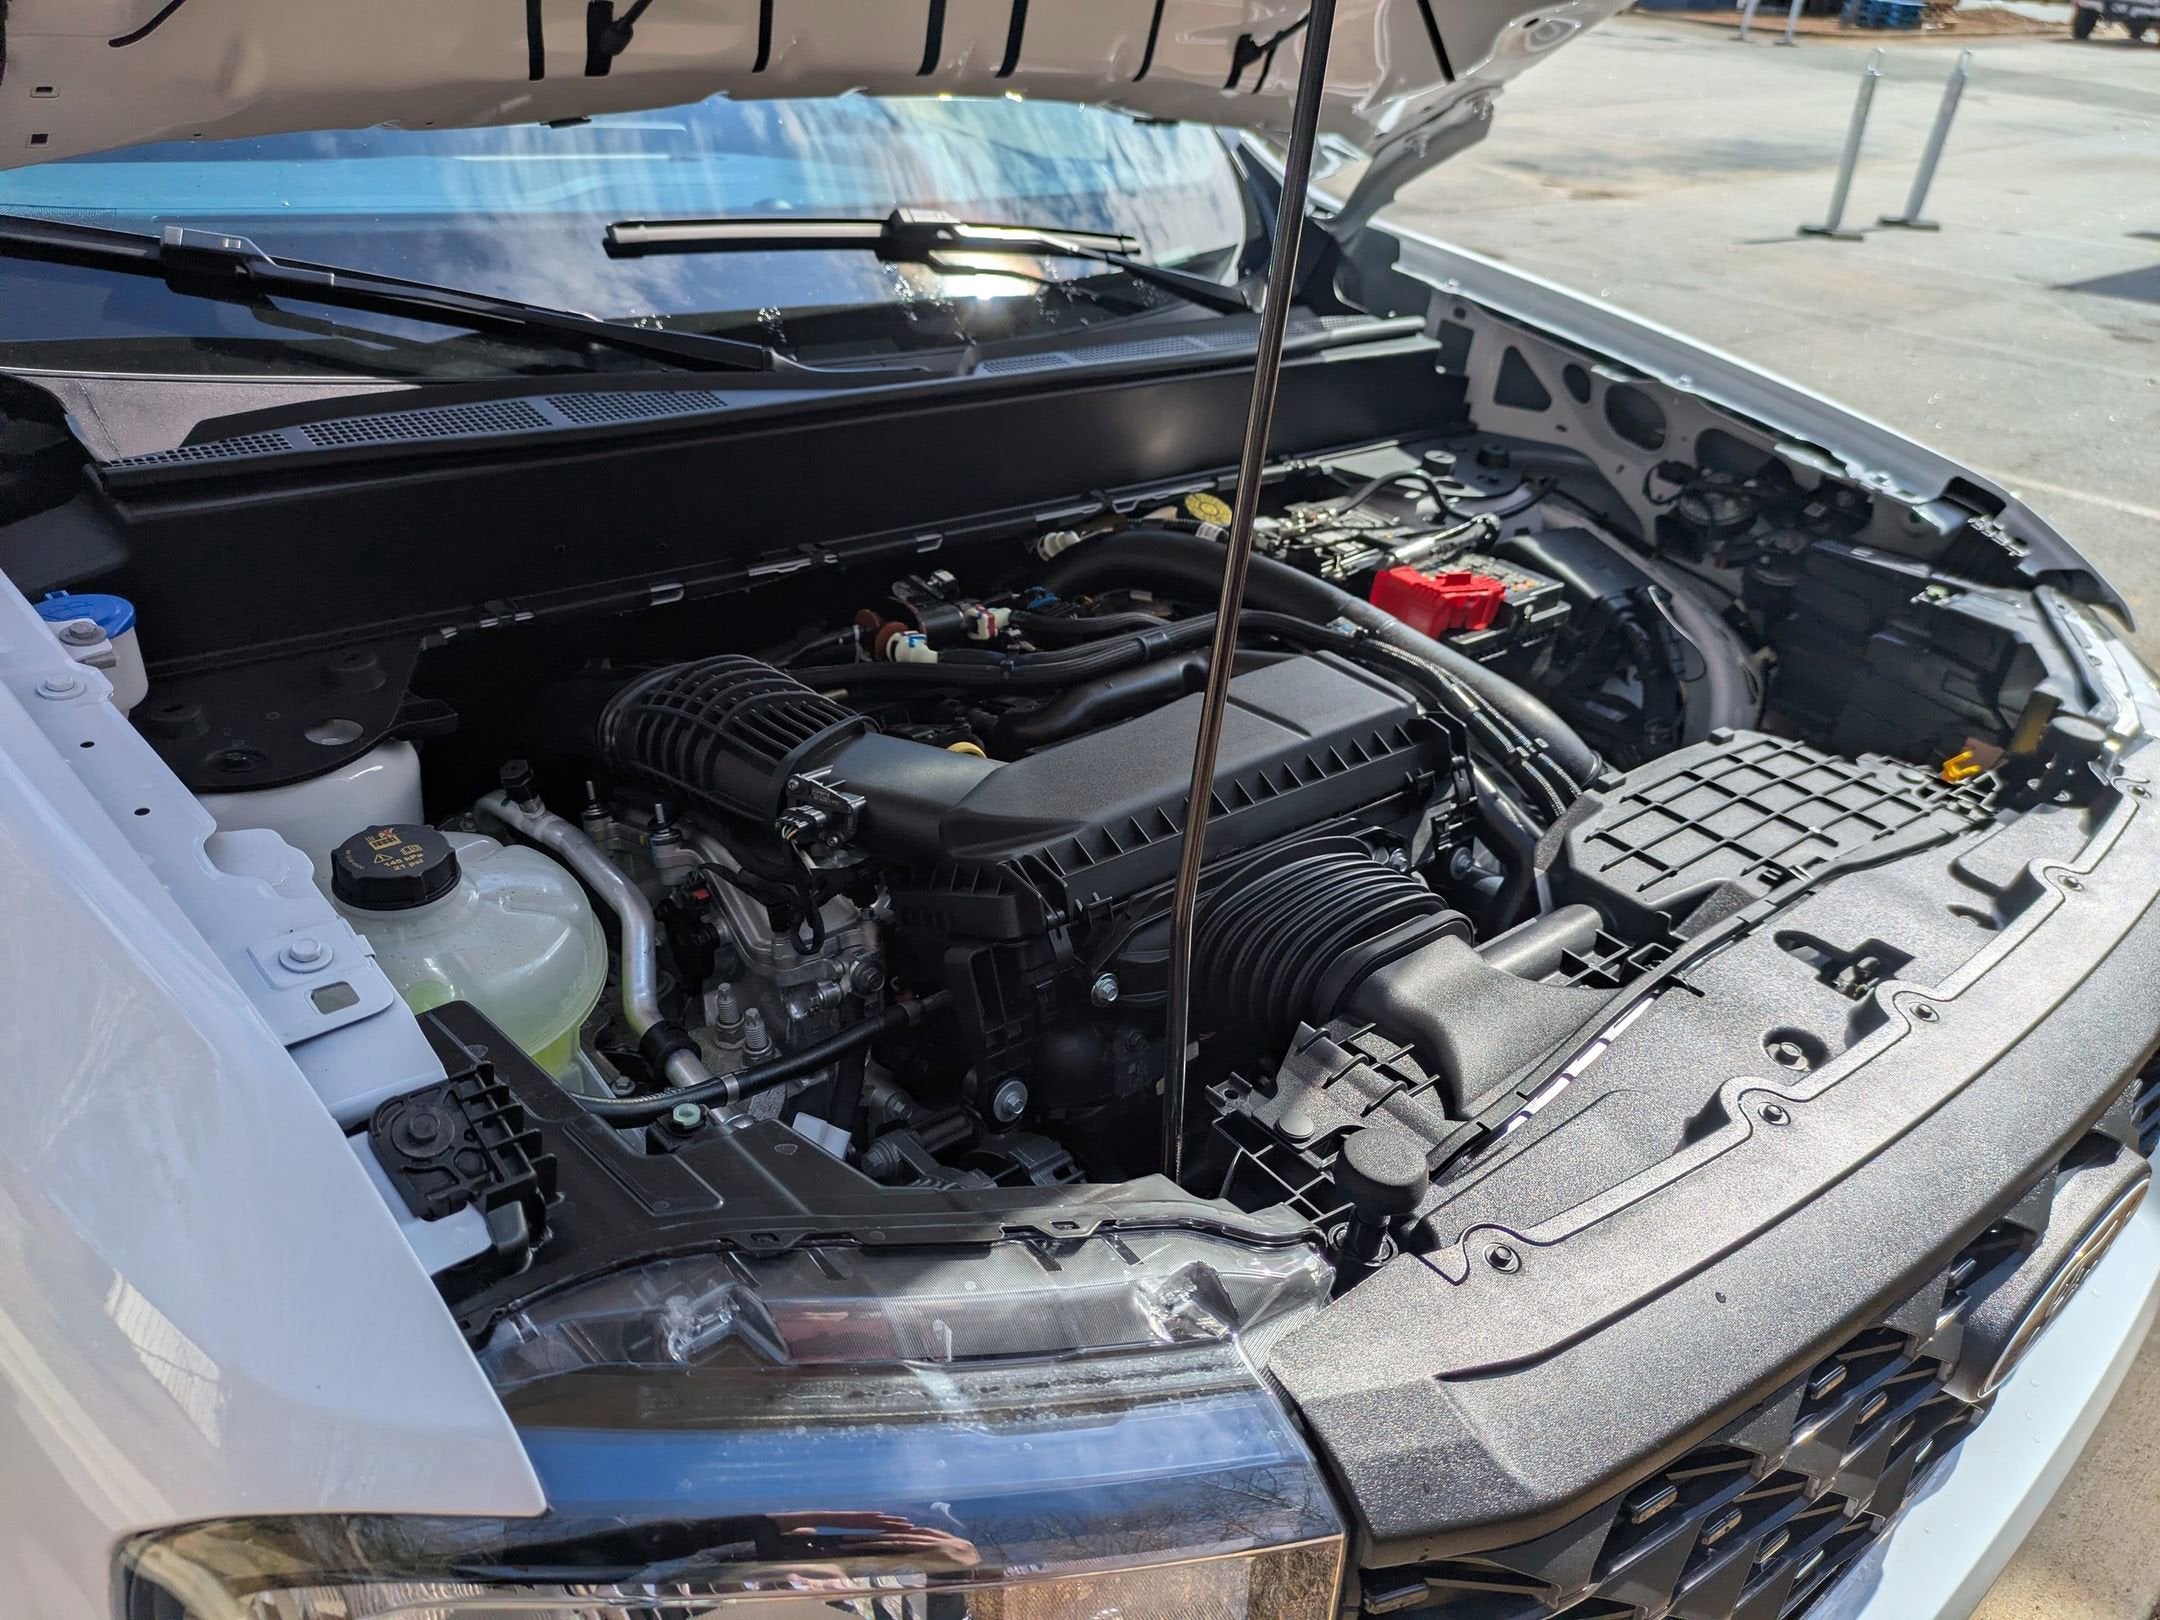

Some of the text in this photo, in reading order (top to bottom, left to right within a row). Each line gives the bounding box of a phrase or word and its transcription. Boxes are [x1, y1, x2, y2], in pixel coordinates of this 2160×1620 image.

[383, 853, 425, 867] 145 kPa
[408, 858, 425, 867] psi
